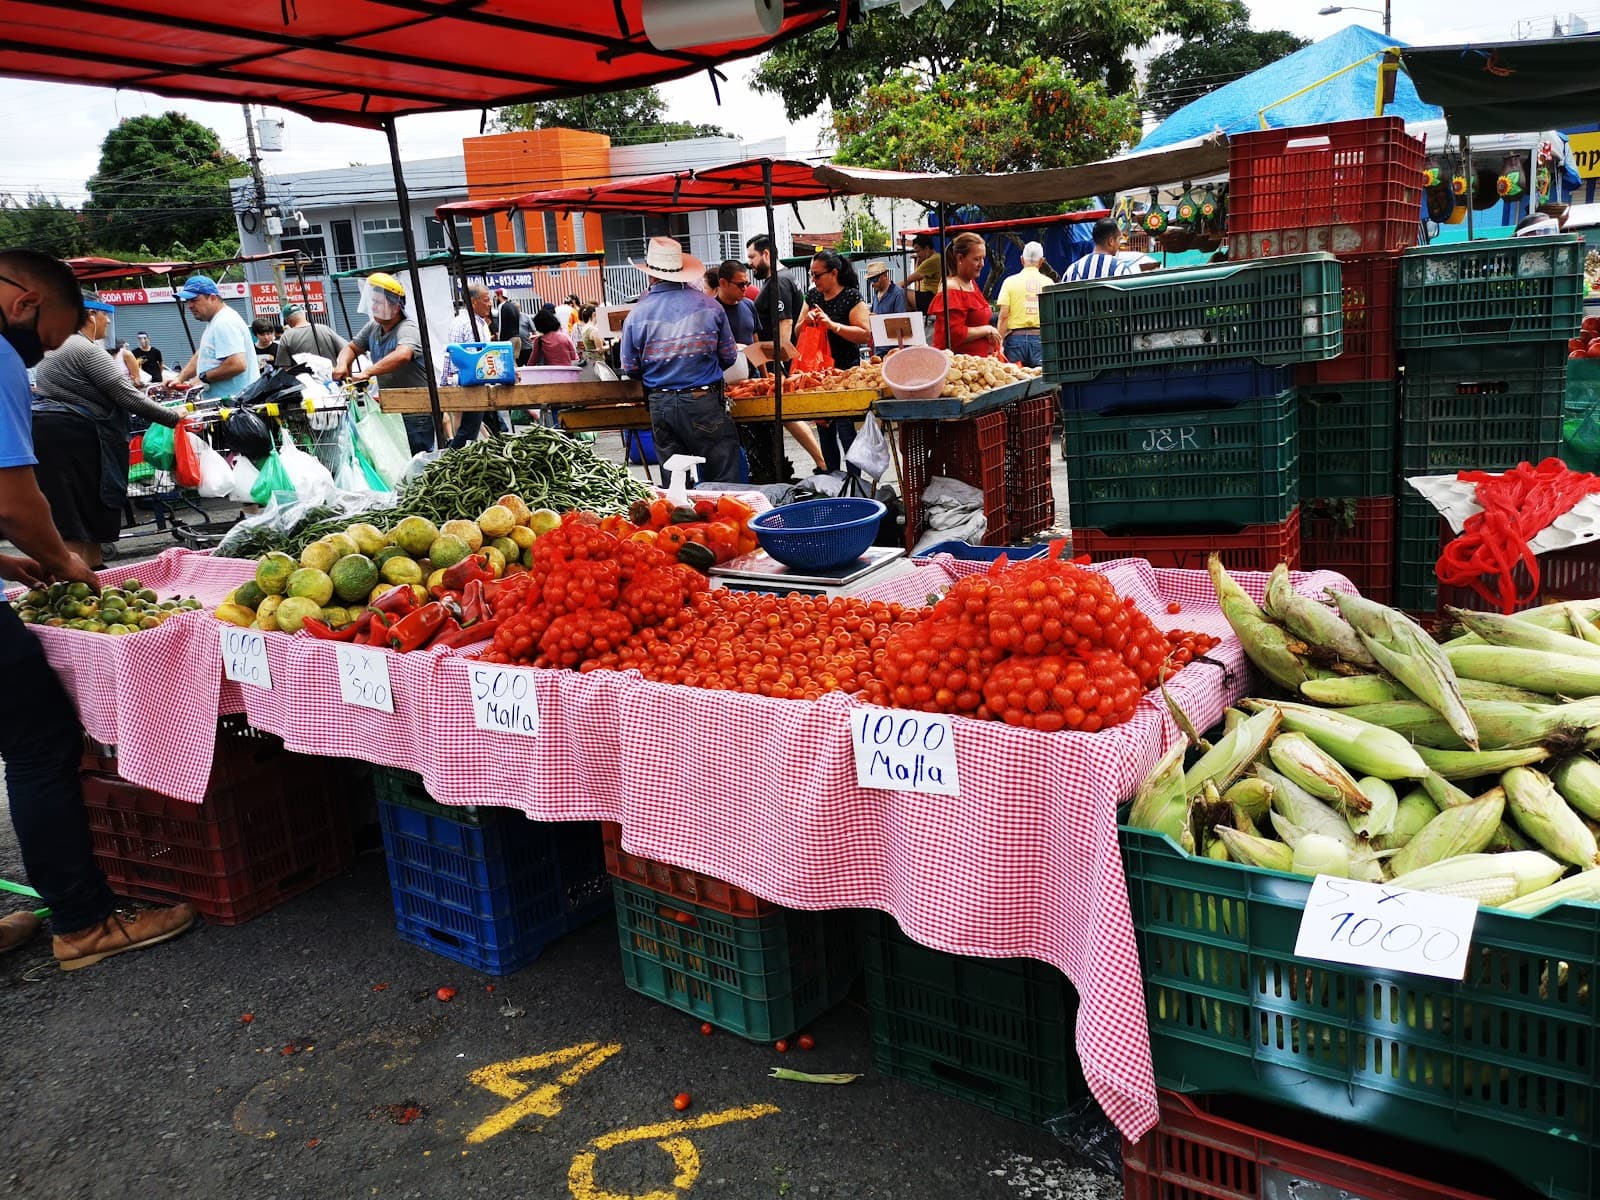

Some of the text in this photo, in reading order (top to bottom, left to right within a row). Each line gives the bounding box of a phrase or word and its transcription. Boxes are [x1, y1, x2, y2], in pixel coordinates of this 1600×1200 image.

[101, 291, 121, 304] SODA
[122, 290, 144, 302] TAY'S
[260, 285, 271, 294] SE
[226, 632, 261, 657] 1000
[352, 677, 387, 705] 500
[475, 671, 527, 700] 500
[486, 702, 534, 731] Malla
[861, 713, 945, 751] 1000
[870, 750, 946, 788] Malla
[1315, 880, 1351, 907] 5
[1330, 912, 1460, 962] 1000
